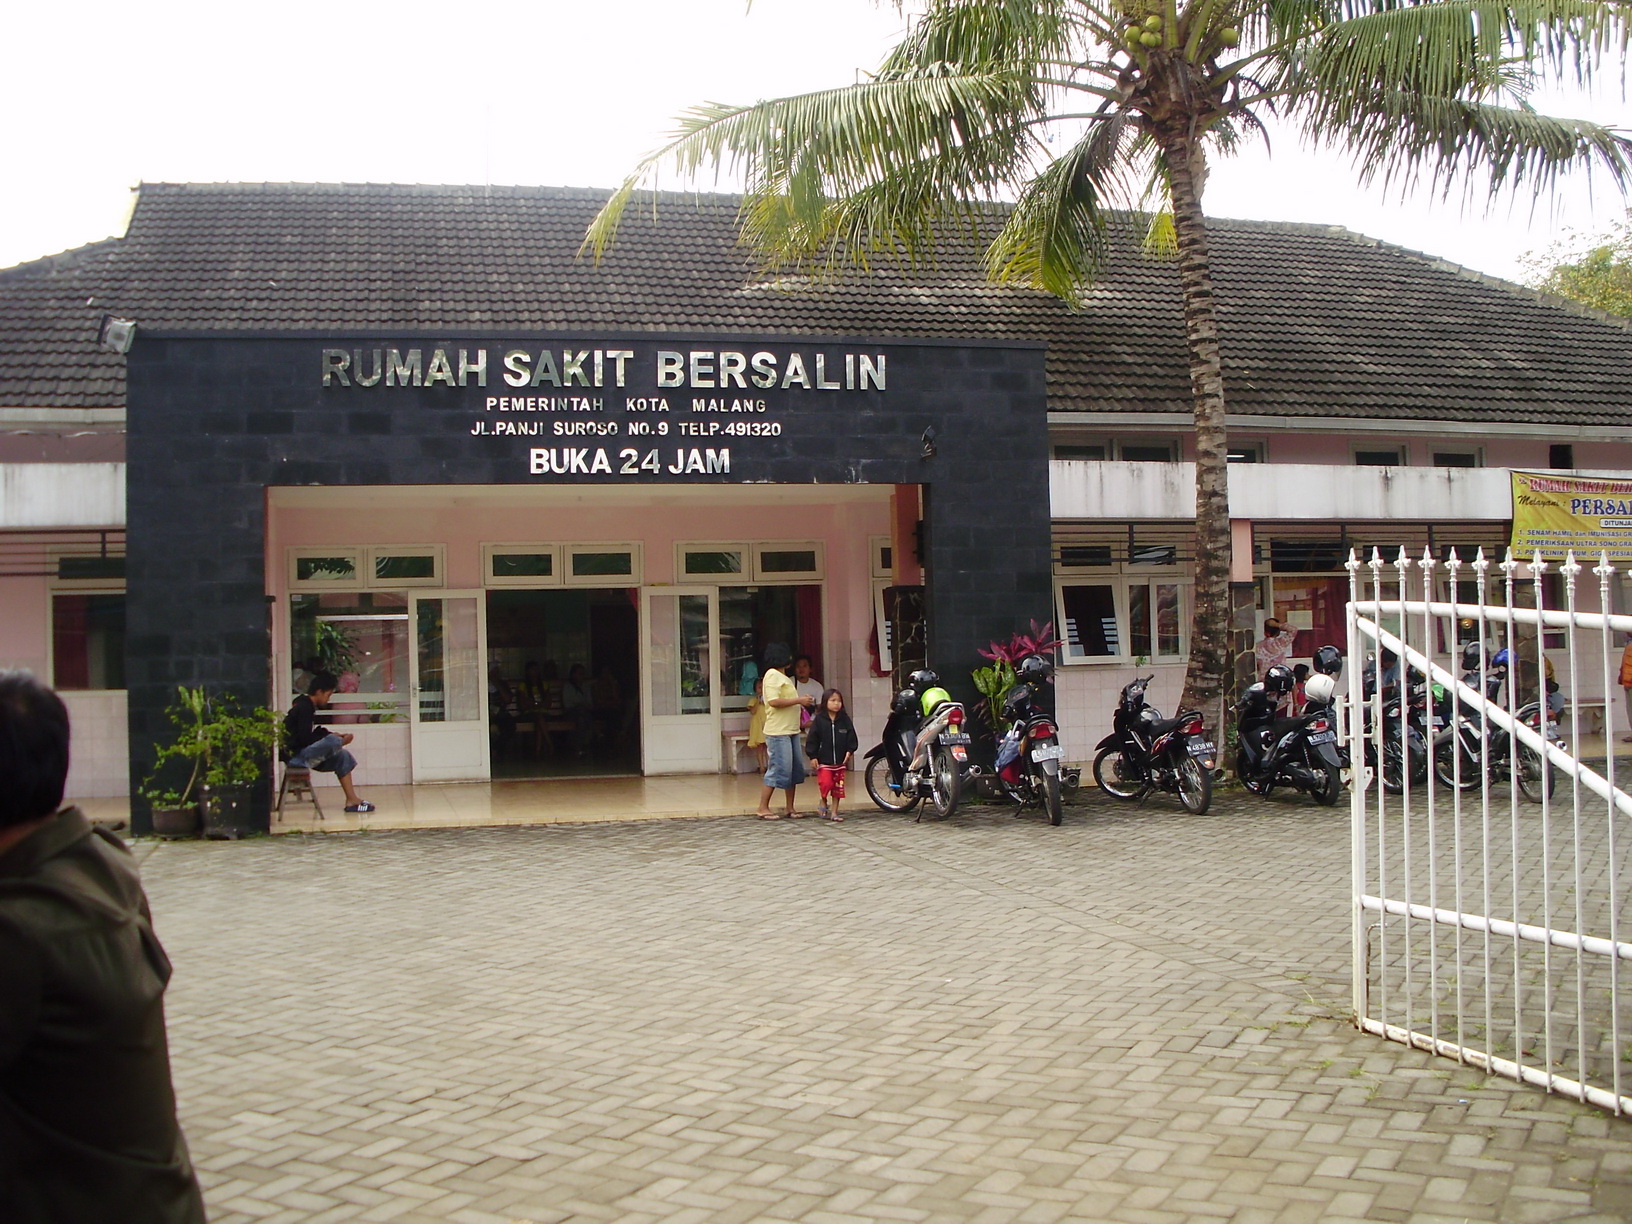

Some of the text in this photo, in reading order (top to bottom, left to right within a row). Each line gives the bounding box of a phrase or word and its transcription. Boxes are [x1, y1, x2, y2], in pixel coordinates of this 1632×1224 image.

[321, 348, 886, 391] RUMAH SAKIT BERSALIN
[486, 397, 767, 413] PEMERINTAH KOTA MALANG
[471, 422, 782, 437] JL.PANJI SUROSO NO.9 TELP.491320
[530, 448, 731, 475] BUKA 24 JAM
[1530, 478, 1571, 492] RUMAH
[1574, 480, 1608, 493] SAKIT
[1517, 495, 1560, 508] Melayani
